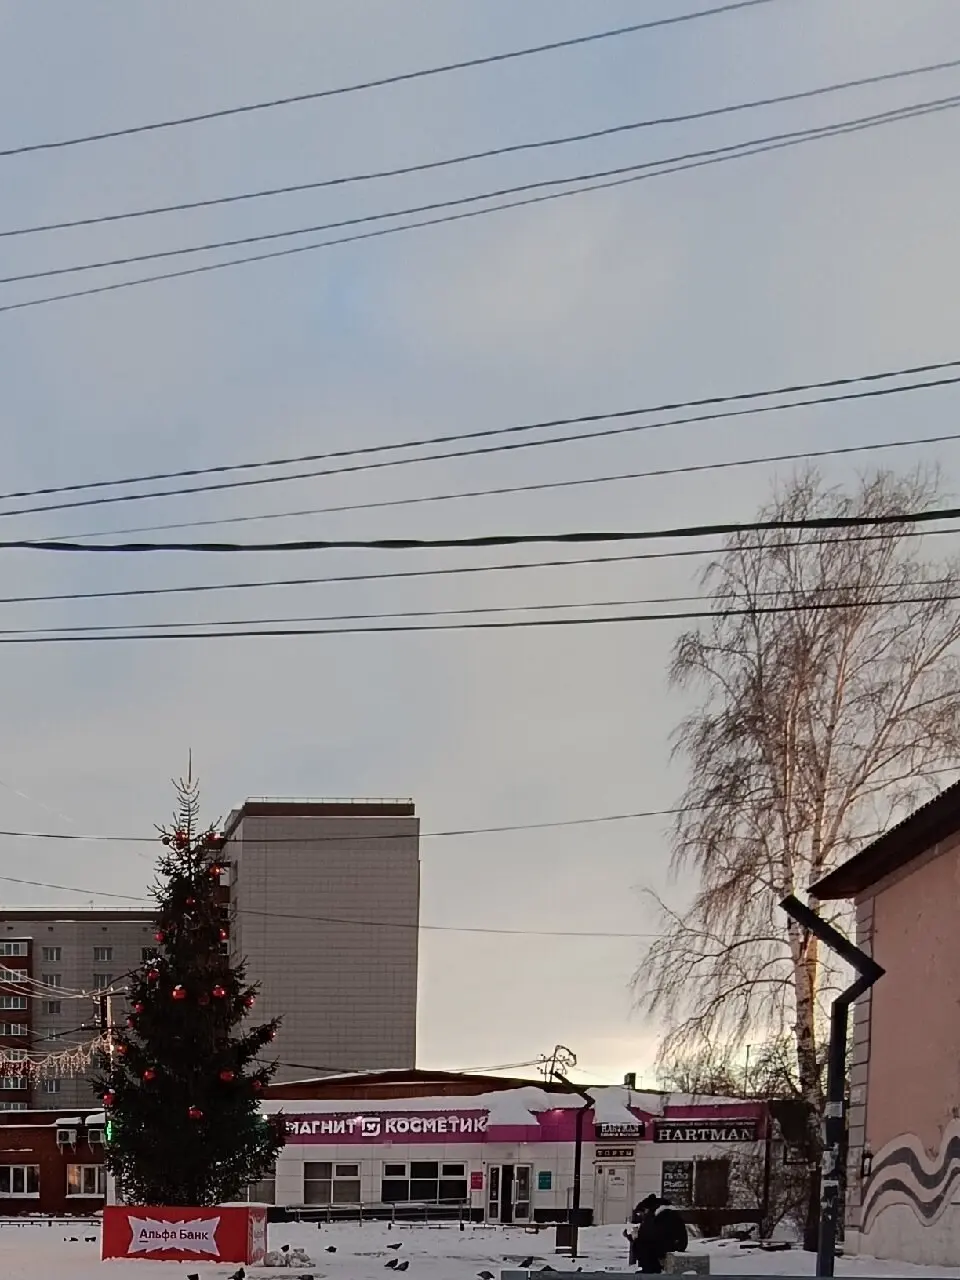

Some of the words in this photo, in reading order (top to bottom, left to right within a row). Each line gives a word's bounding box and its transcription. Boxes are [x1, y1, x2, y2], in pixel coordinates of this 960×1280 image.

[385, 1117, 488, 1133] КОСМЕТИК
[658, 1129, 755, 1141] HARTMAN
[139, 1228, 177, 1242] Альфа
[179, 1229, 209, 1240] Банк
